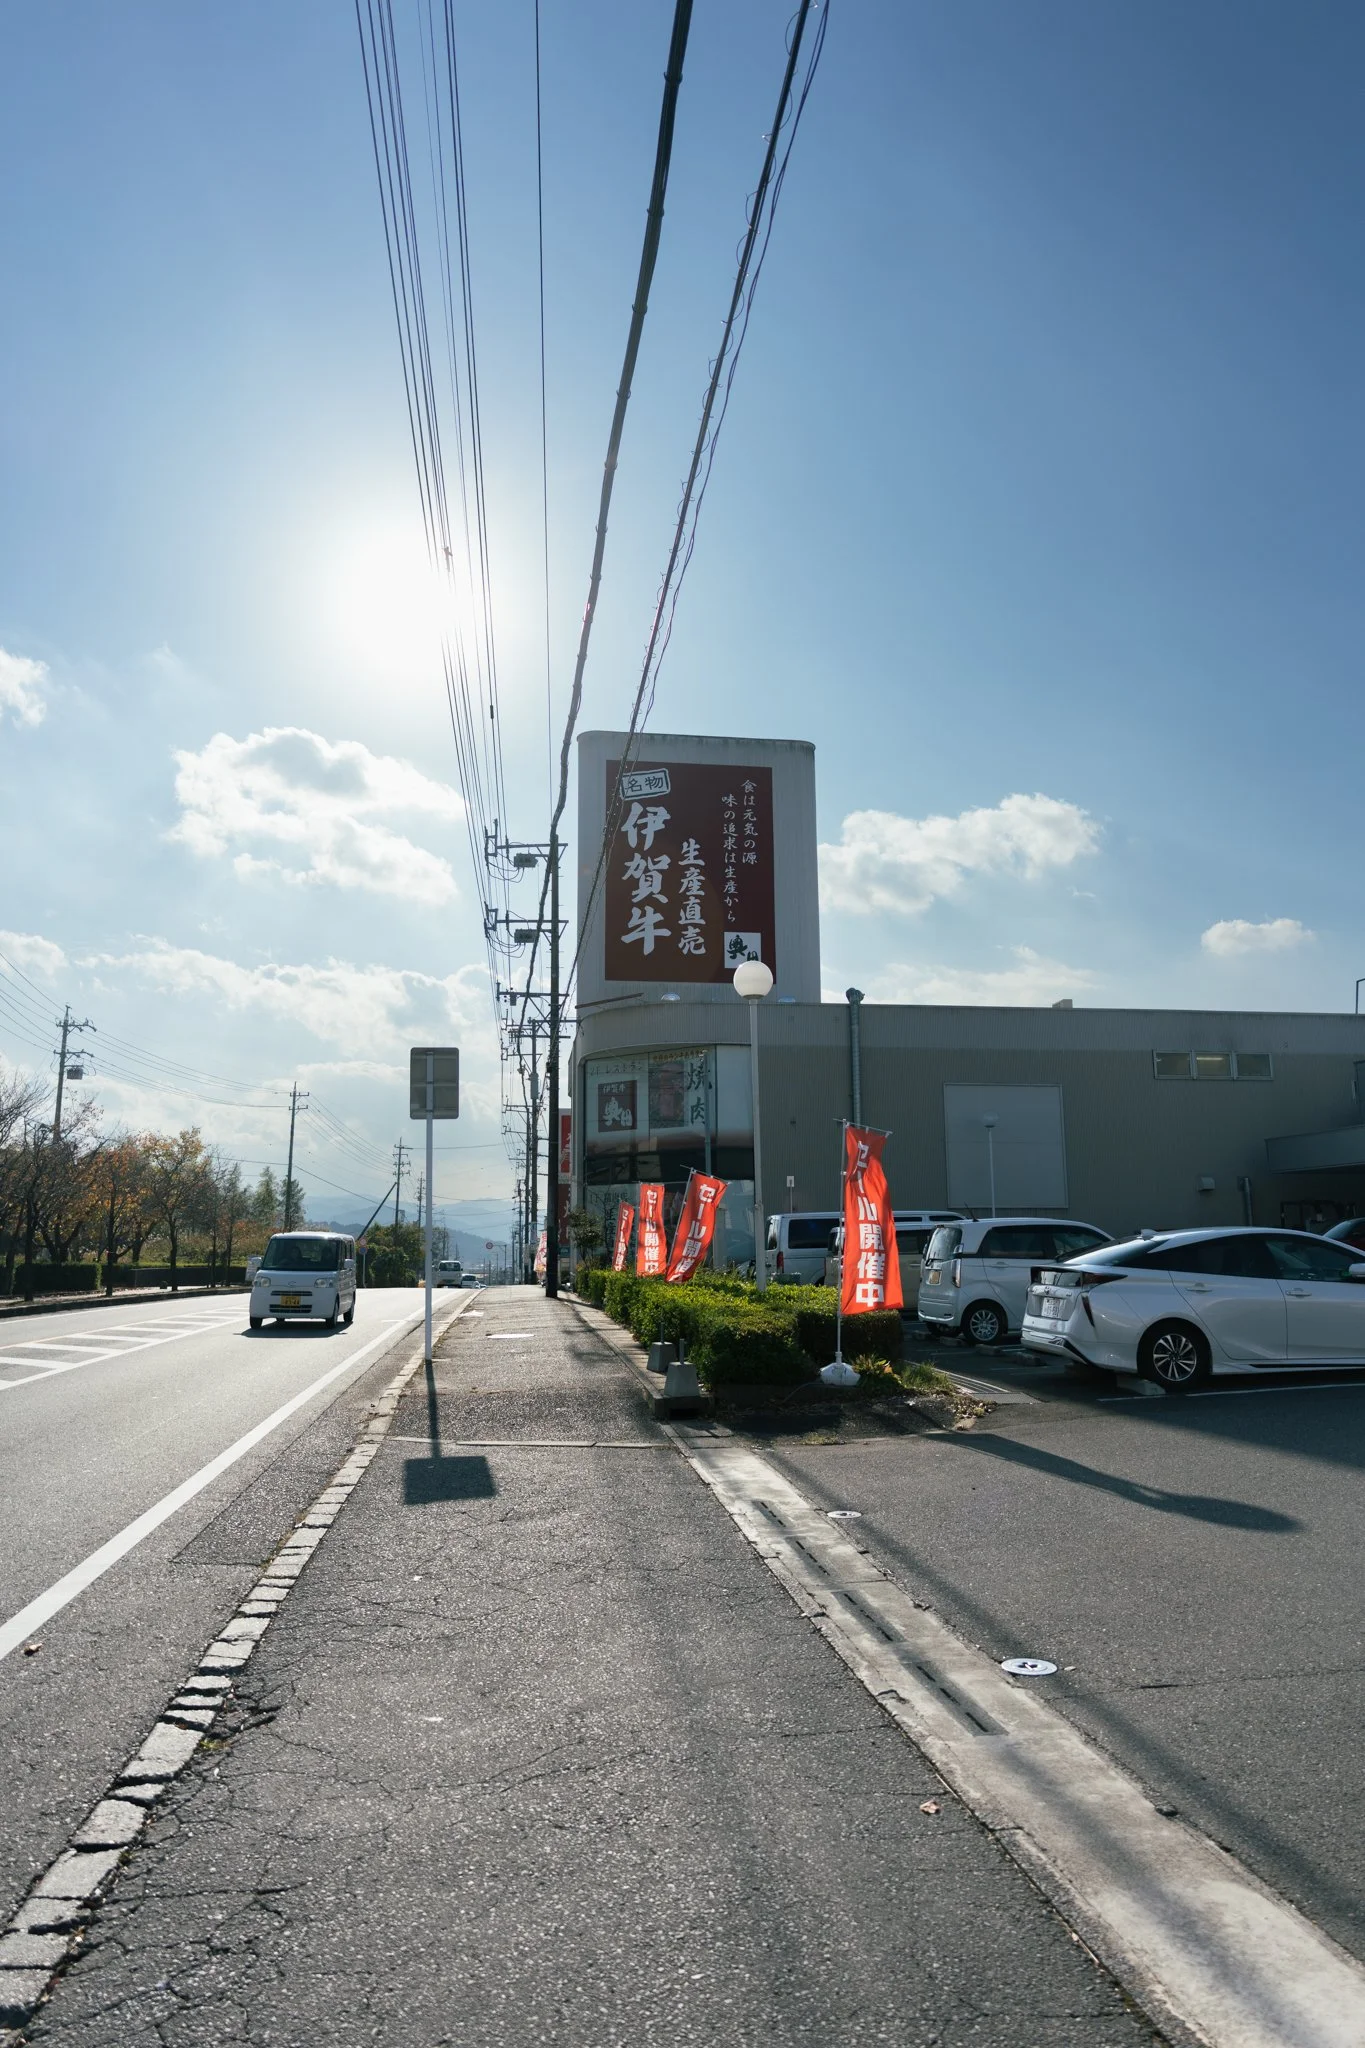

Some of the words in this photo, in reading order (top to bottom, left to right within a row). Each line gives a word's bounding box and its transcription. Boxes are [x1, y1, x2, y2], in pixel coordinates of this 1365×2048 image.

[625, 776, 664, 793] 名物
[741, 779, 759, 865] 食は元気の源
[621, 801, 672, 956] 伊賀牛
[678, 838, 706, 955] 生産直売
[721, 793, 739, 923] 味の追求は生産から
[854, 1140, 885, 1307] セール開催中
